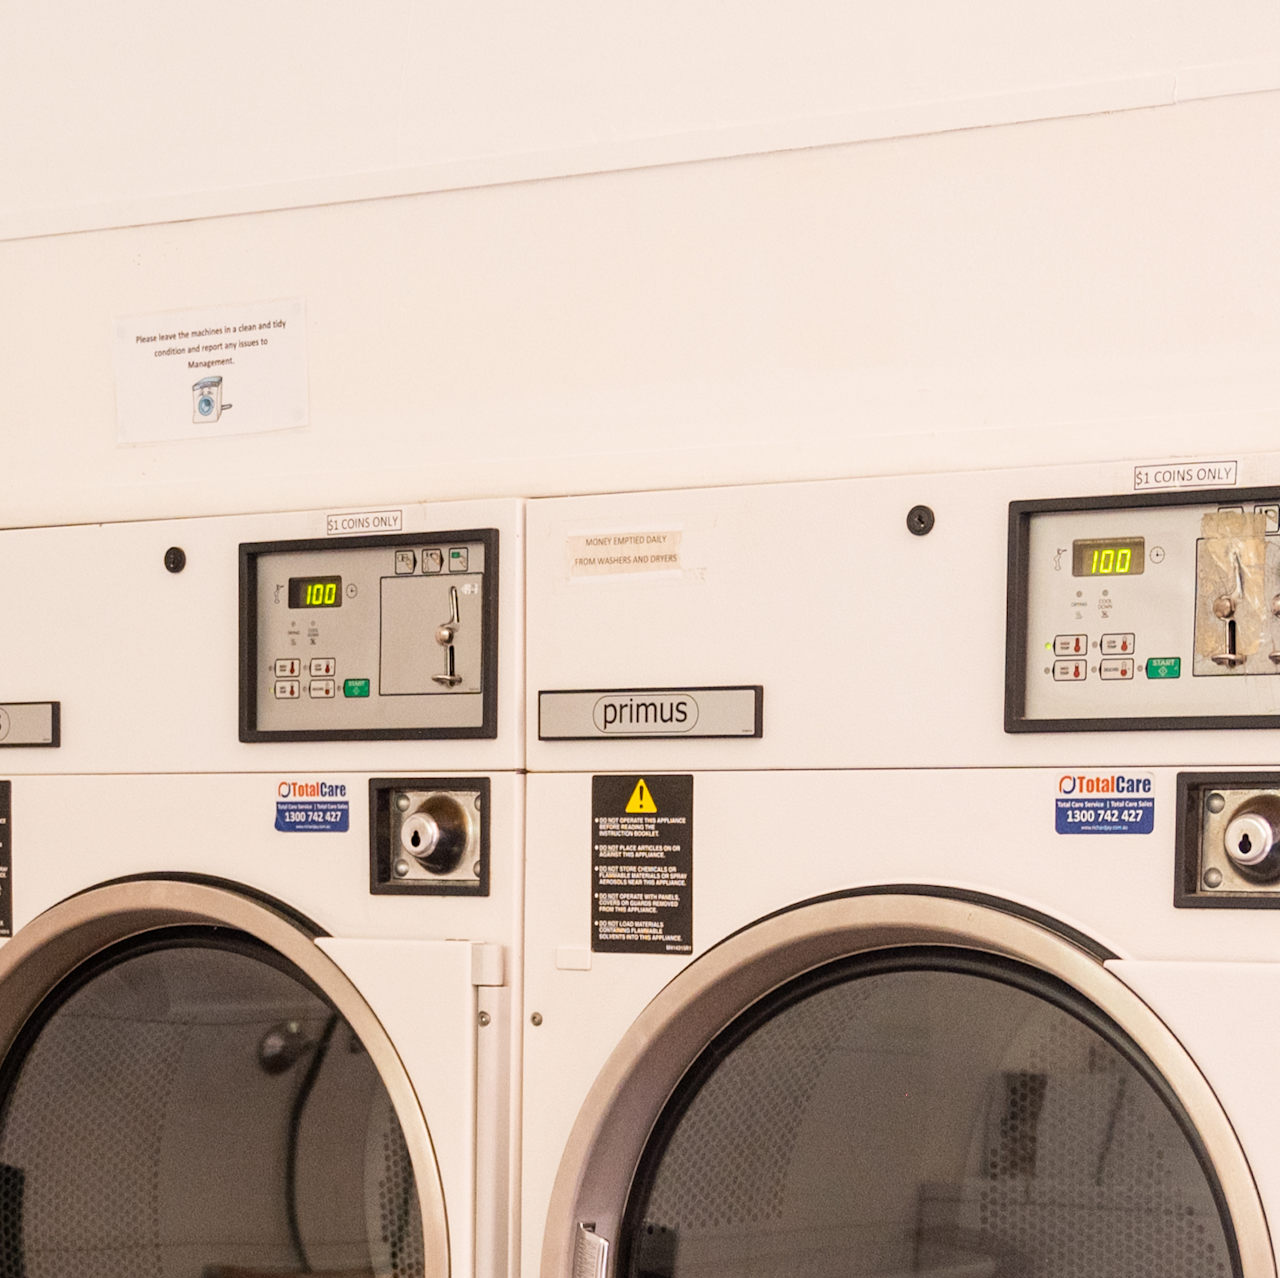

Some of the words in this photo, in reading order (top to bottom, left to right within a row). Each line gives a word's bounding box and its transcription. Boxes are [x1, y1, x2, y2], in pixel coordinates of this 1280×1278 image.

[136, 335, 156, 344] Please
[159, 333, 176, 342] leave
[178, 331, 189, 340] the
[191, 328, 222, 338] machines
[238, 323, 256, 333] clean
[258, 321, 270, 330] and
[272, 319, 286, 329] tidy
[154, 346, 185, 357] condition
[188, 344, 200, 354] and
[202, 343, 222, 354] report
[224, 342, 237, 350] any
[238, 339, 258, 348] issues
[1136, 471, 1149, 486] $1
[1154, 468, 1193, 483] COINS
[1197, 467, 1232, 481] ONLY
[328, 519, 338, 531] $1
[342, 517, 370, 529] COINS
[373, 516, 398, 528] ONLY
[614, 536, 644, 545] EMPTIED
[647, 535, 667, 544] DAILY
[598, 556, 631, 565] WASHERS
[651, 554, 677, 562] DRYERS
[1092, 548, 1131, 574] 100
[307, 584, 336, 605] 100
[603, 698, 688, 730] primus
[291, 782, 346, 797] TotalCare
[1077, 776, 1151, 793] TotalCare
[285, 812, 306, 822] 1300
[308, 812, 323, 822] 742
[325, 812, 341, 822] 427
[1067, 810, 1094, 822] 1300
[1098, 810, 1118, 822] 742
[1121, 810, 1143, 822] 427
